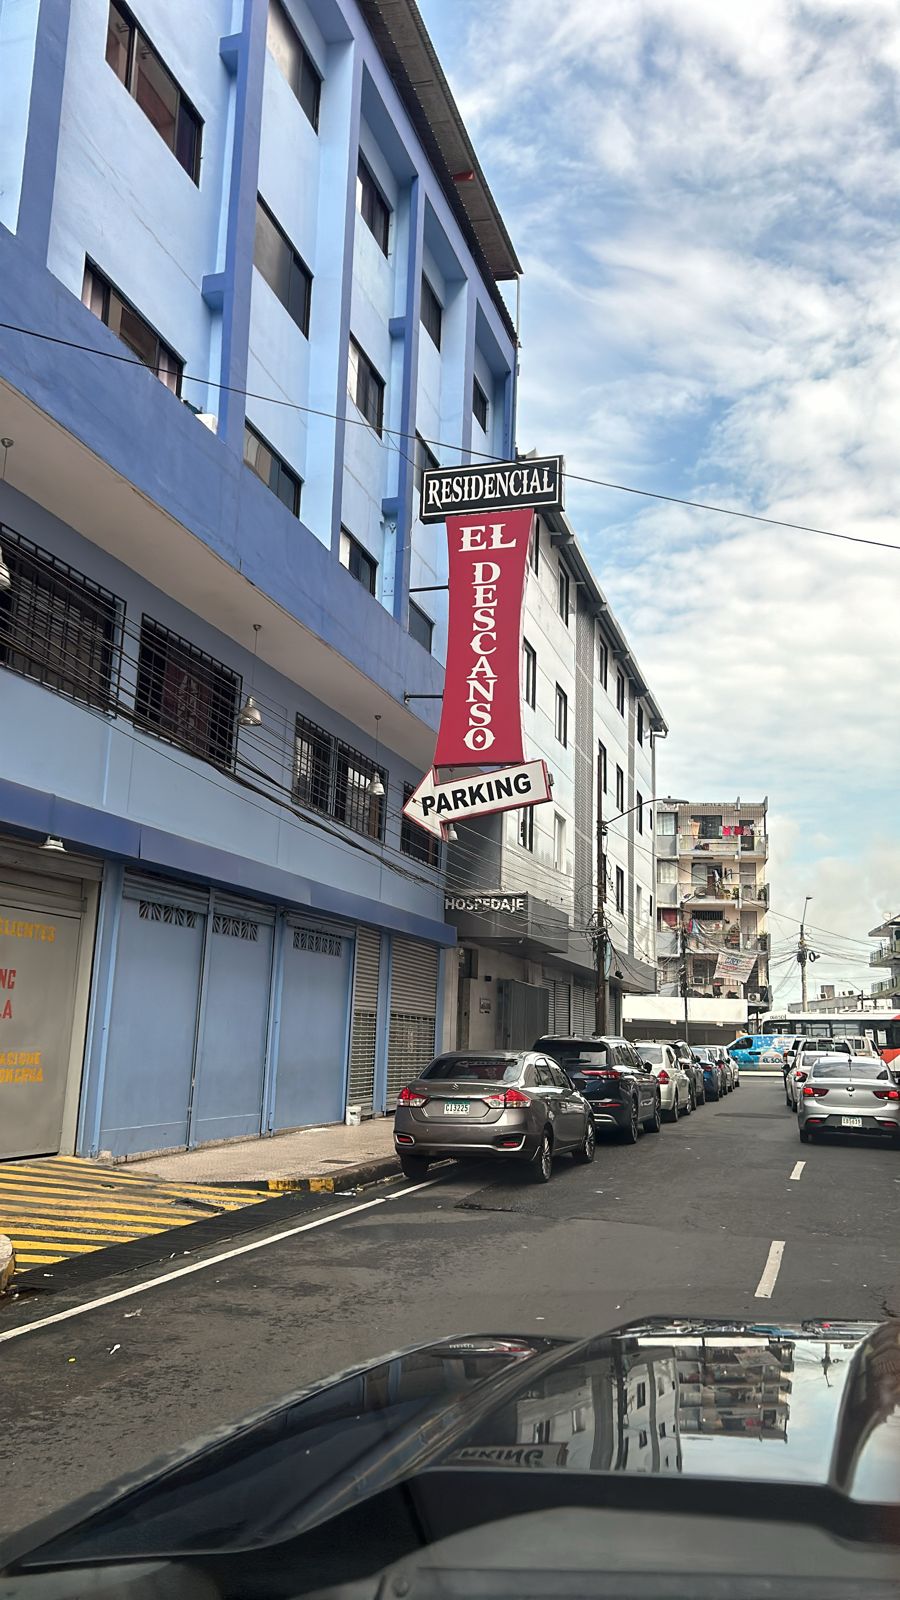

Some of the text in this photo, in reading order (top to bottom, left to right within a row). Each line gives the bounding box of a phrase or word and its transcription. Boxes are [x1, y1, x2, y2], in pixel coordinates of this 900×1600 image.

[427, 467, 554, 509] RESIDENCIAL
[458, 523, 517, 552] EL
[463, 561, 500, 751] DESCANSO
[421, 773, 532, 816] PARKING
[445, 898, 525, 913] HOSPEDAJE
